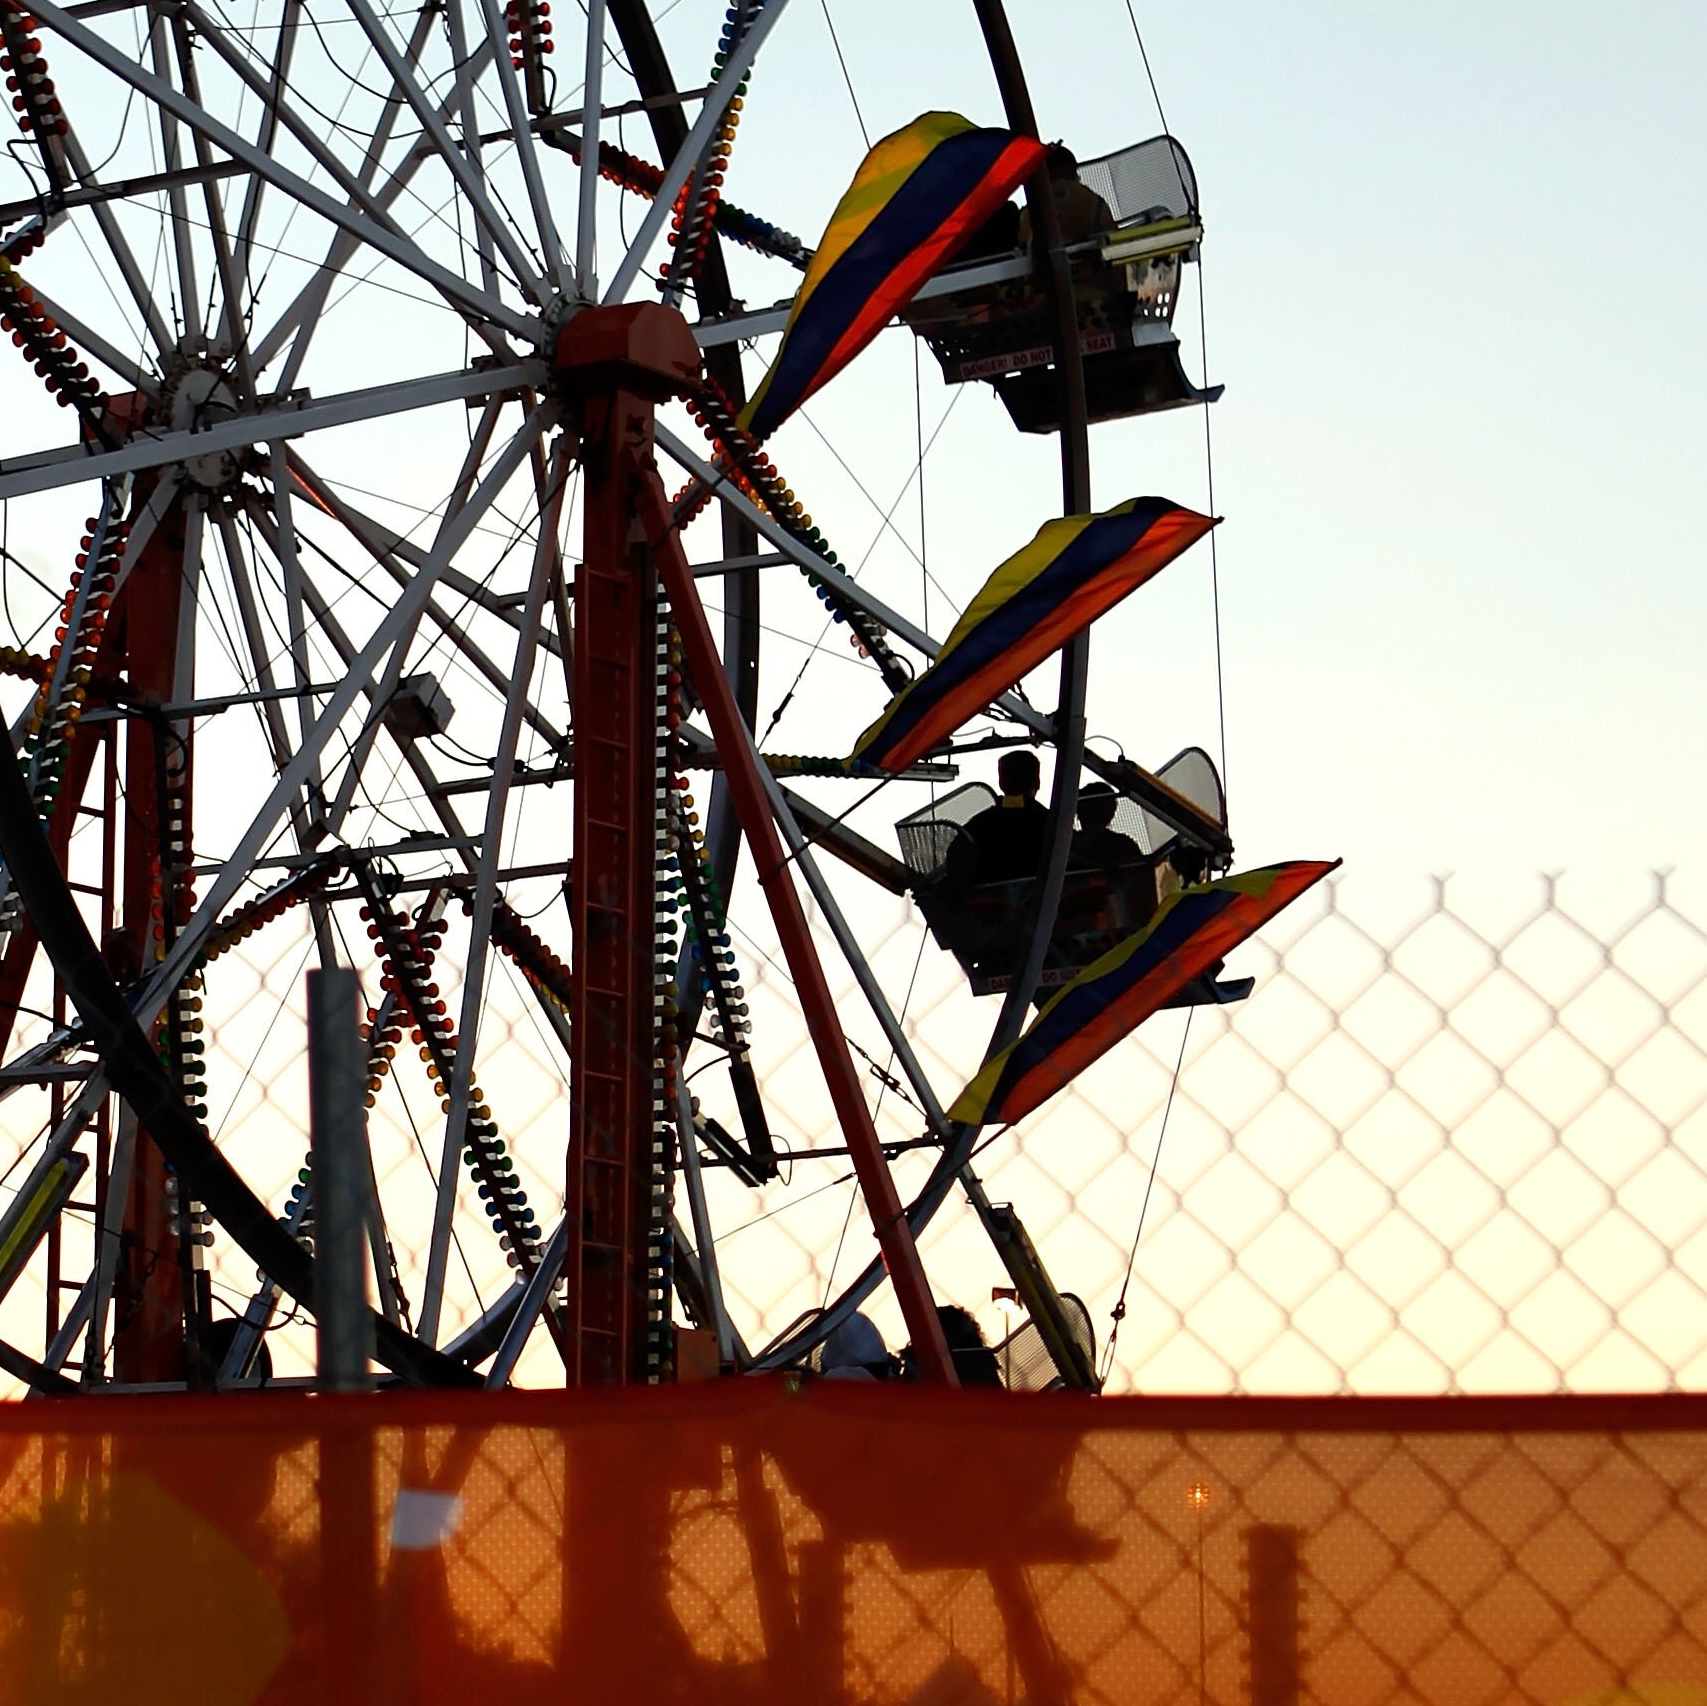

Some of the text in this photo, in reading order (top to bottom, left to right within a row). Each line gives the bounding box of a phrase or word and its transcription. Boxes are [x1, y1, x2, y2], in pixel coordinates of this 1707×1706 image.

[962, 335, 1113, 376] DANGER! DO NOT SEAT
